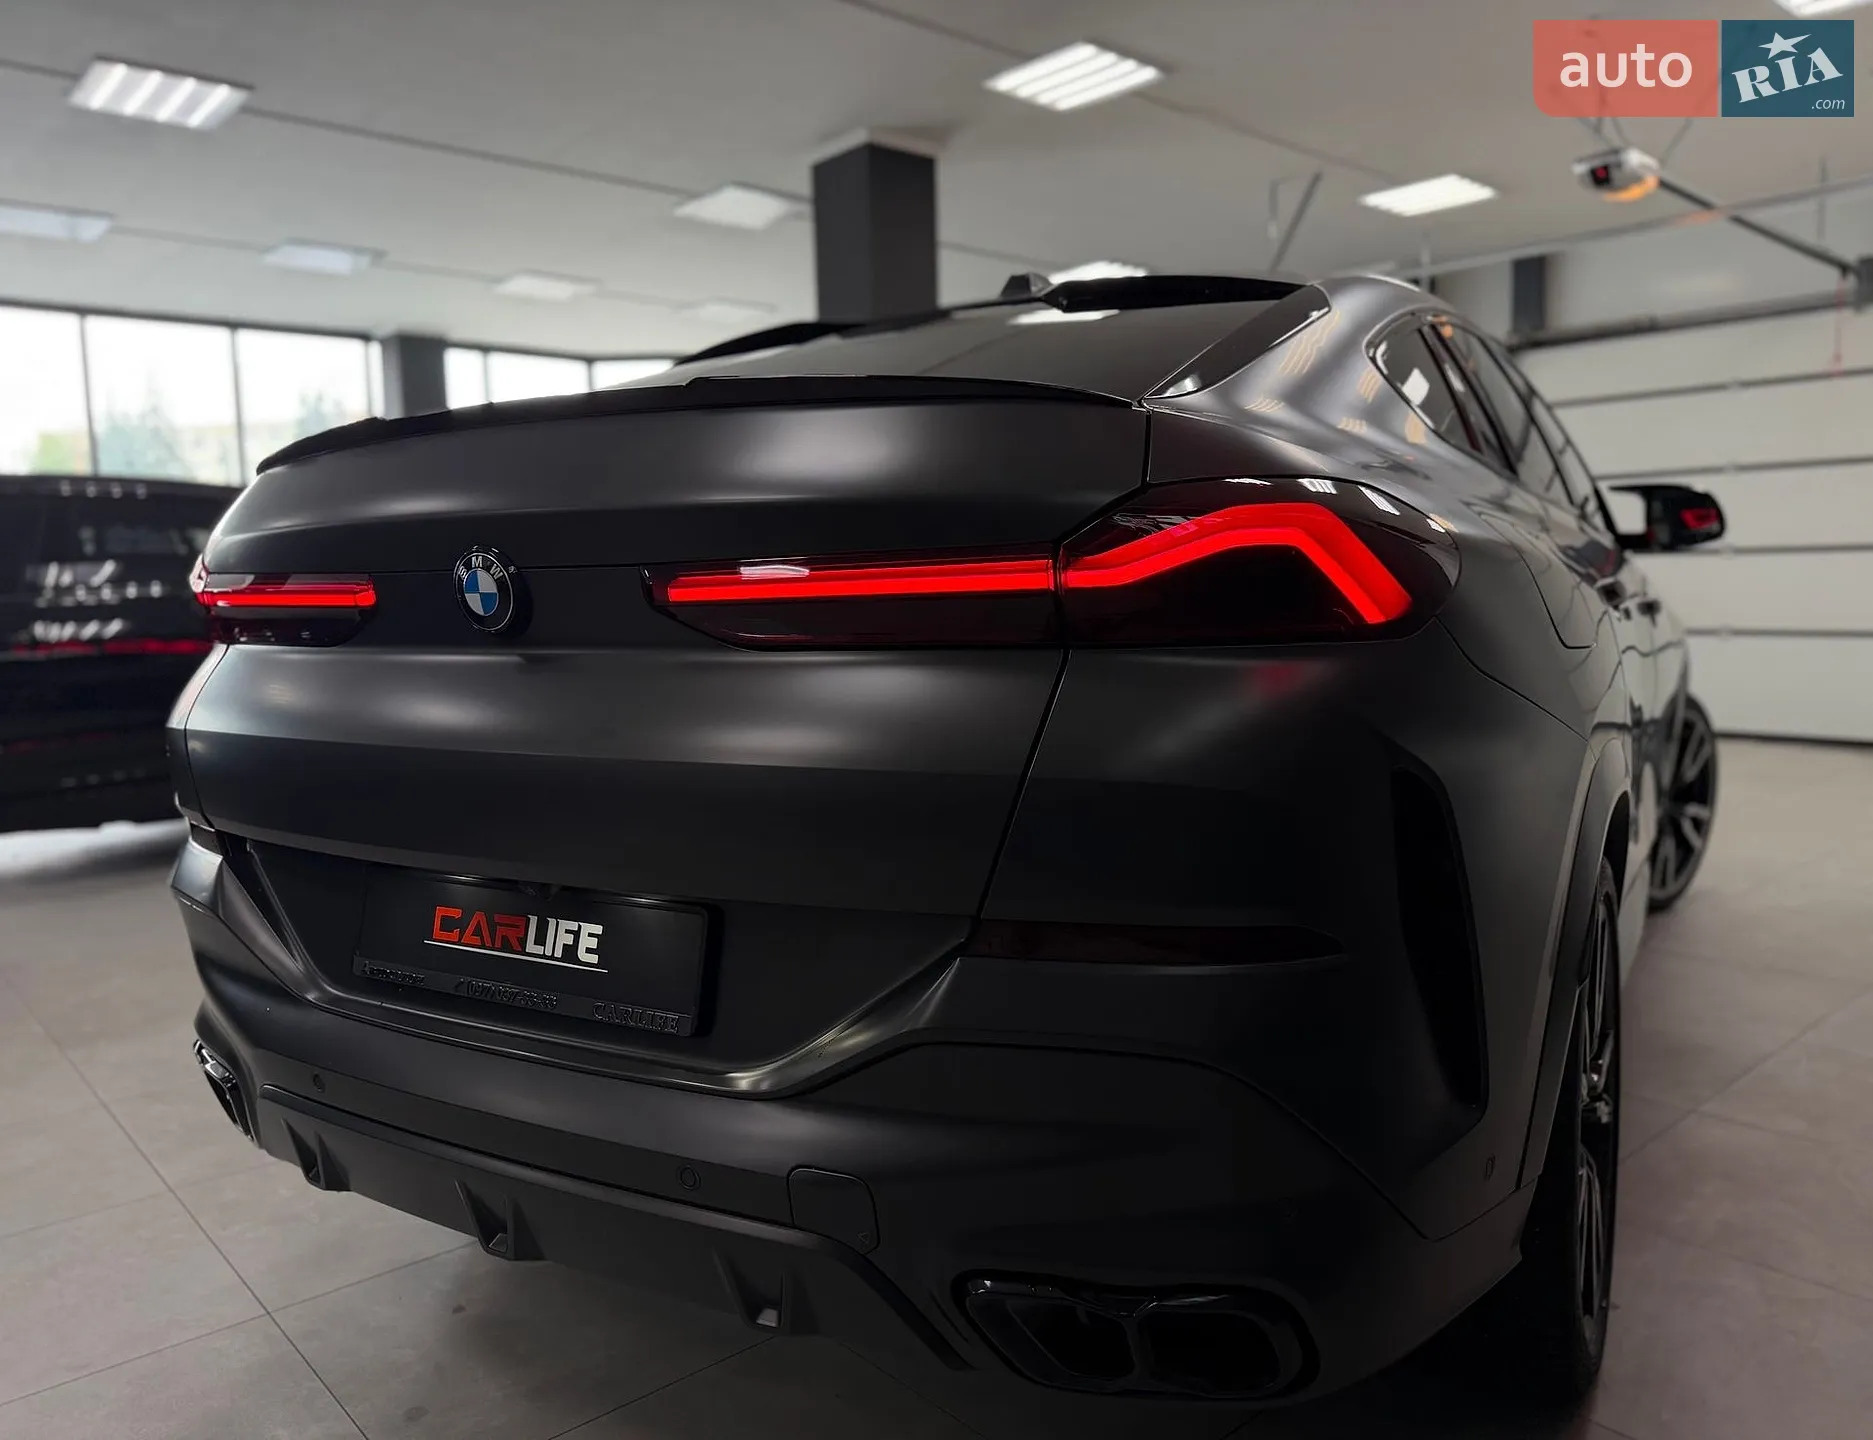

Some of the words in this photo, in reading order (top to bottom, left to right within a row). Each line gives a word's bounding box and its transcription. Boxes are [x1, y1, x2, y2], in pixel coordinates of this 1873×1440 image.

[458, 555, 503, 580] BMW
[432, 906, 603, 964] CARLIFE
[592, 1002, 679, 1033] CARLIFE
